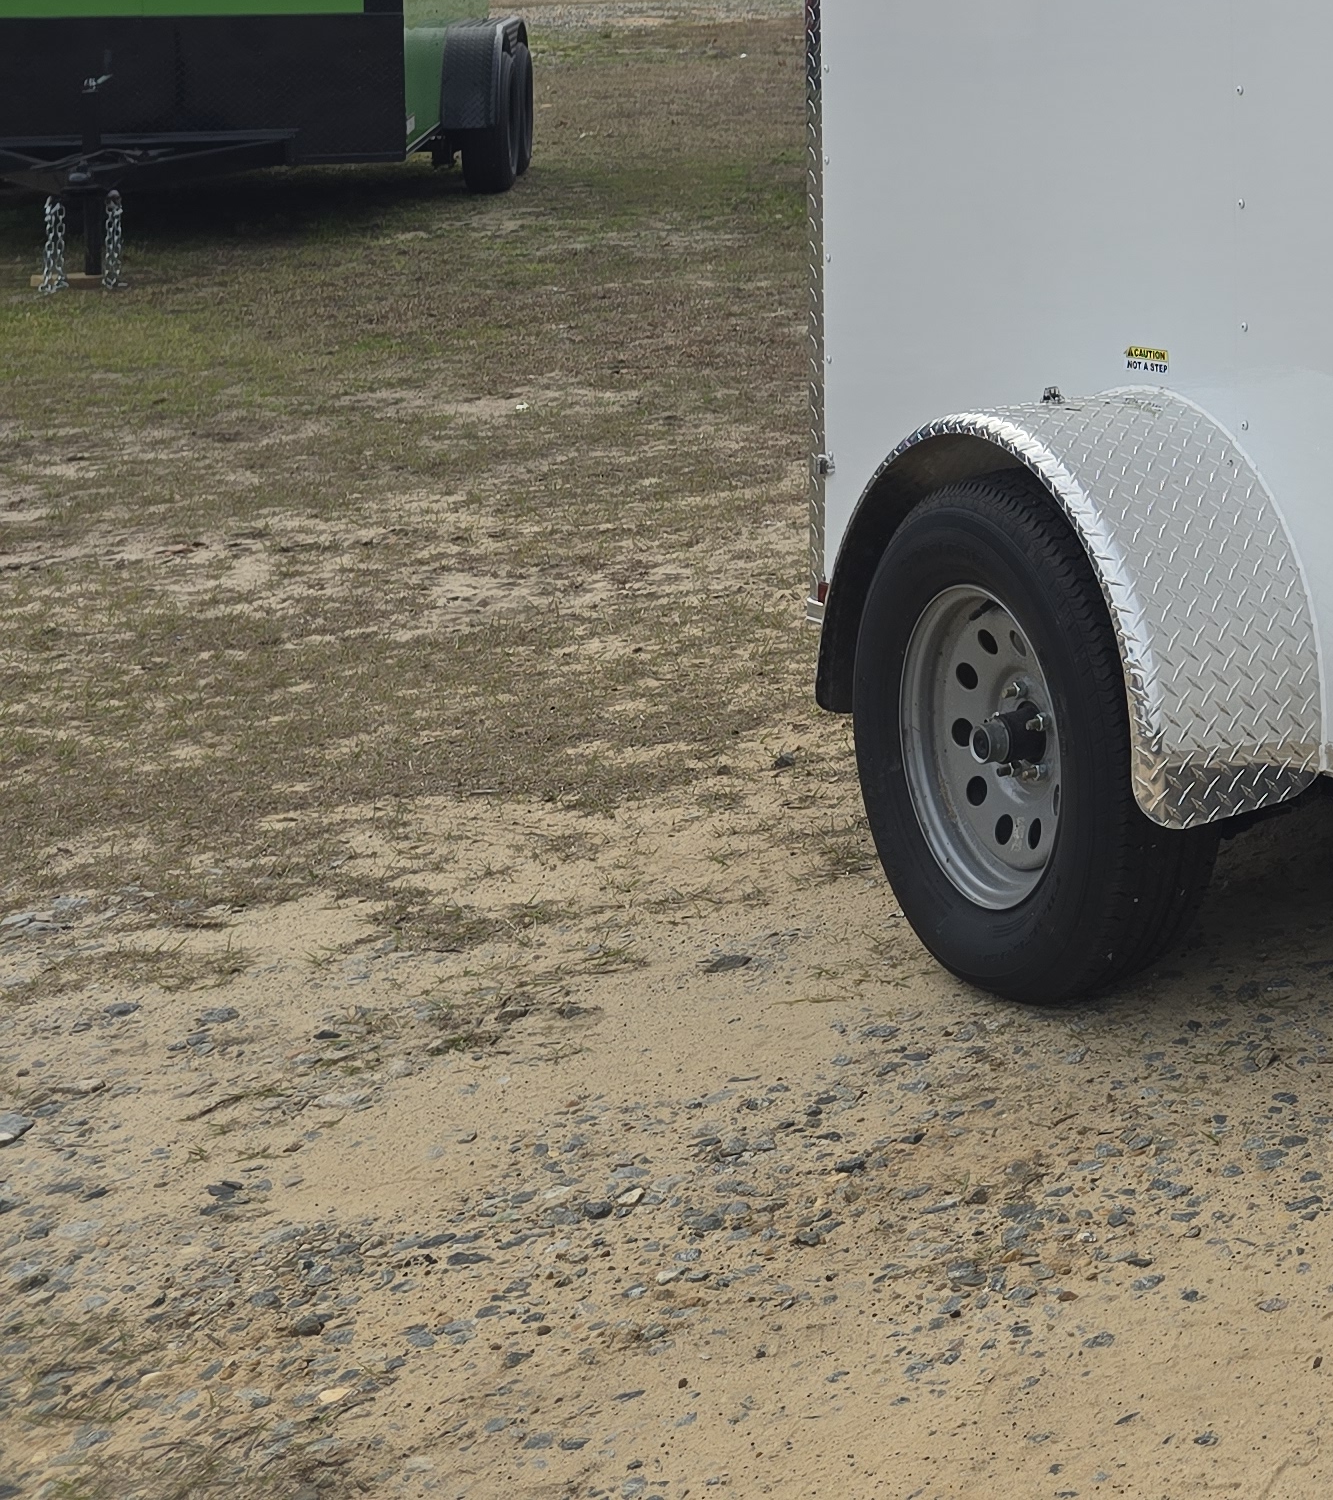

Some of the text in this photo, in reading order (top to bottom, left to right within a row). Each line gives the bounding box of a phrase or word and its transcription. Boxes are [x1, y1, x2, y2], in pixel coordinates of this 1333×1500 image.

[1134, 348, 1166, 360] CAUTION
[1127, 360, 1168, 373] NOT A STEP
